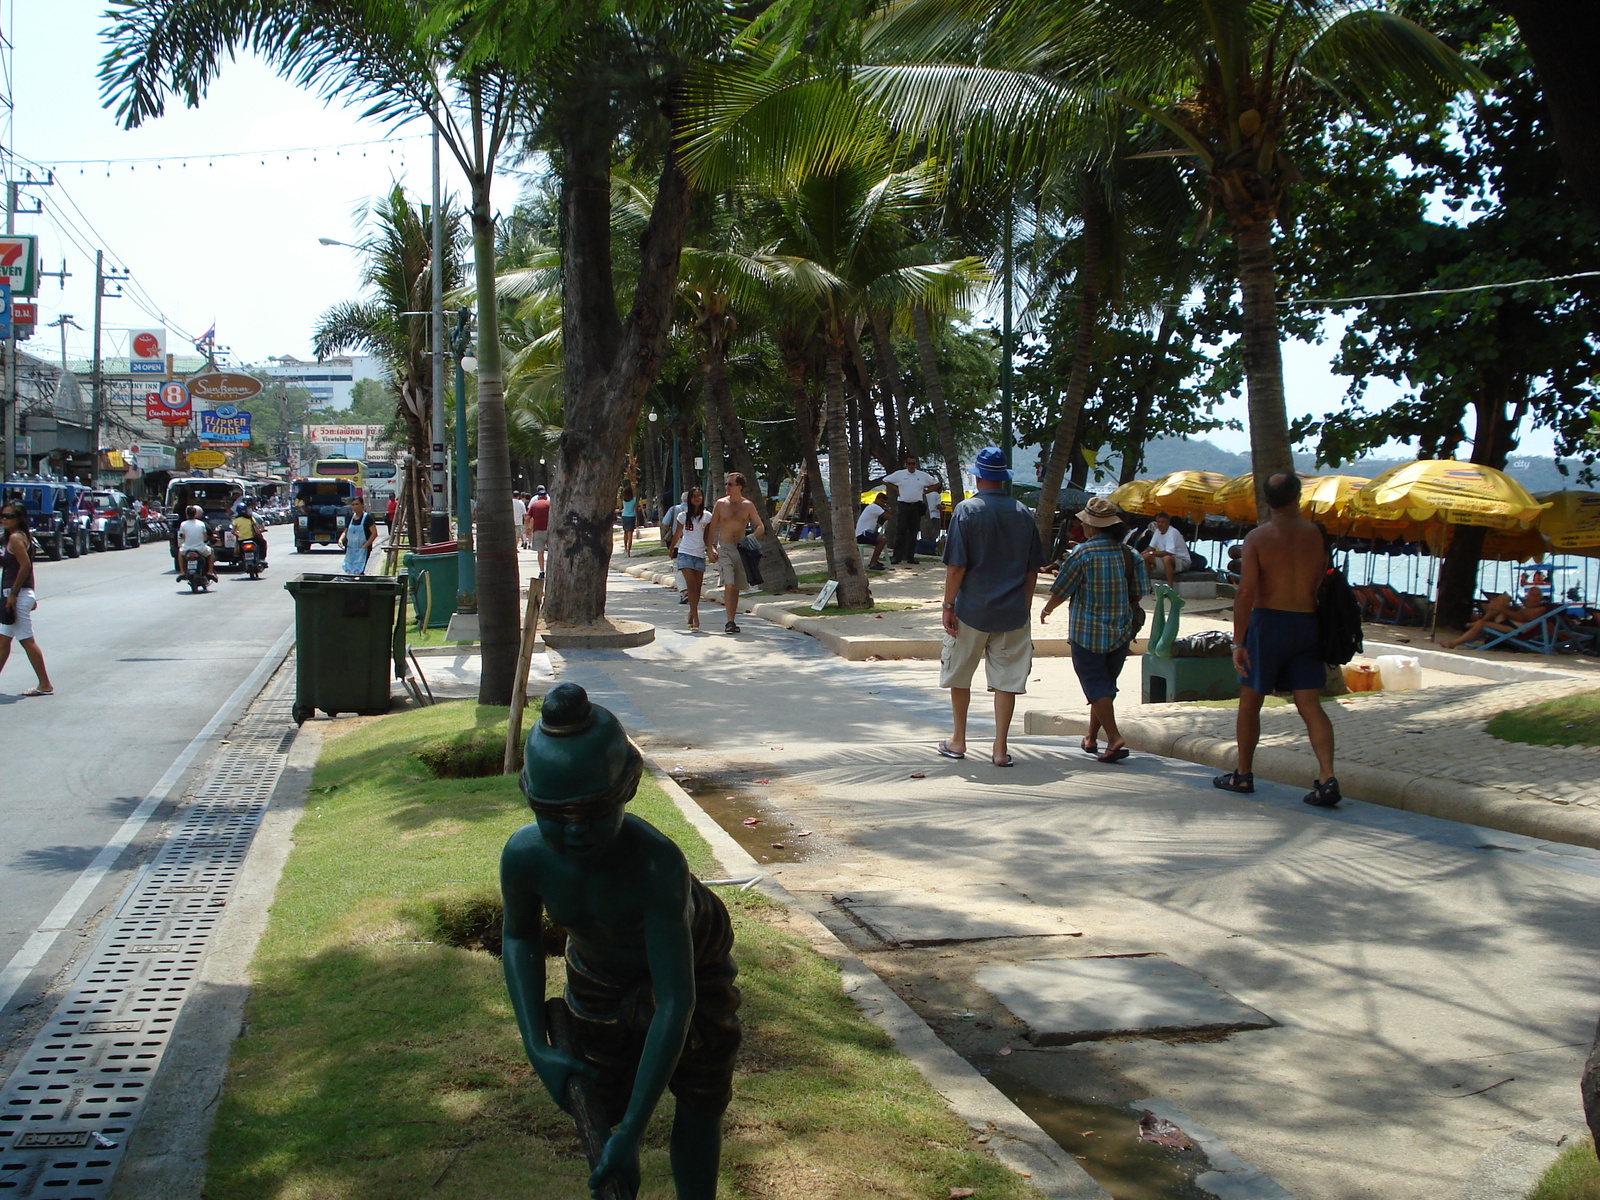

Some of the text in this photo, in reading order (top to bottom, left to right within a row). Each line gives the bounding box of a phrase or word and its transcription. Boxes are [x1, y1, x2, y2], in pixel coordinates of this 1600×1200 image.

[133, 363, 162, 371] 24 OPEN
[166, 385, 182, 405] 8
[148, 409, 190, 417] Center Point
[205, 415, 246, 428] FLIPPER
[206, 424, 241, 435] LODGE
[1513, 459, 1531, 470] city
